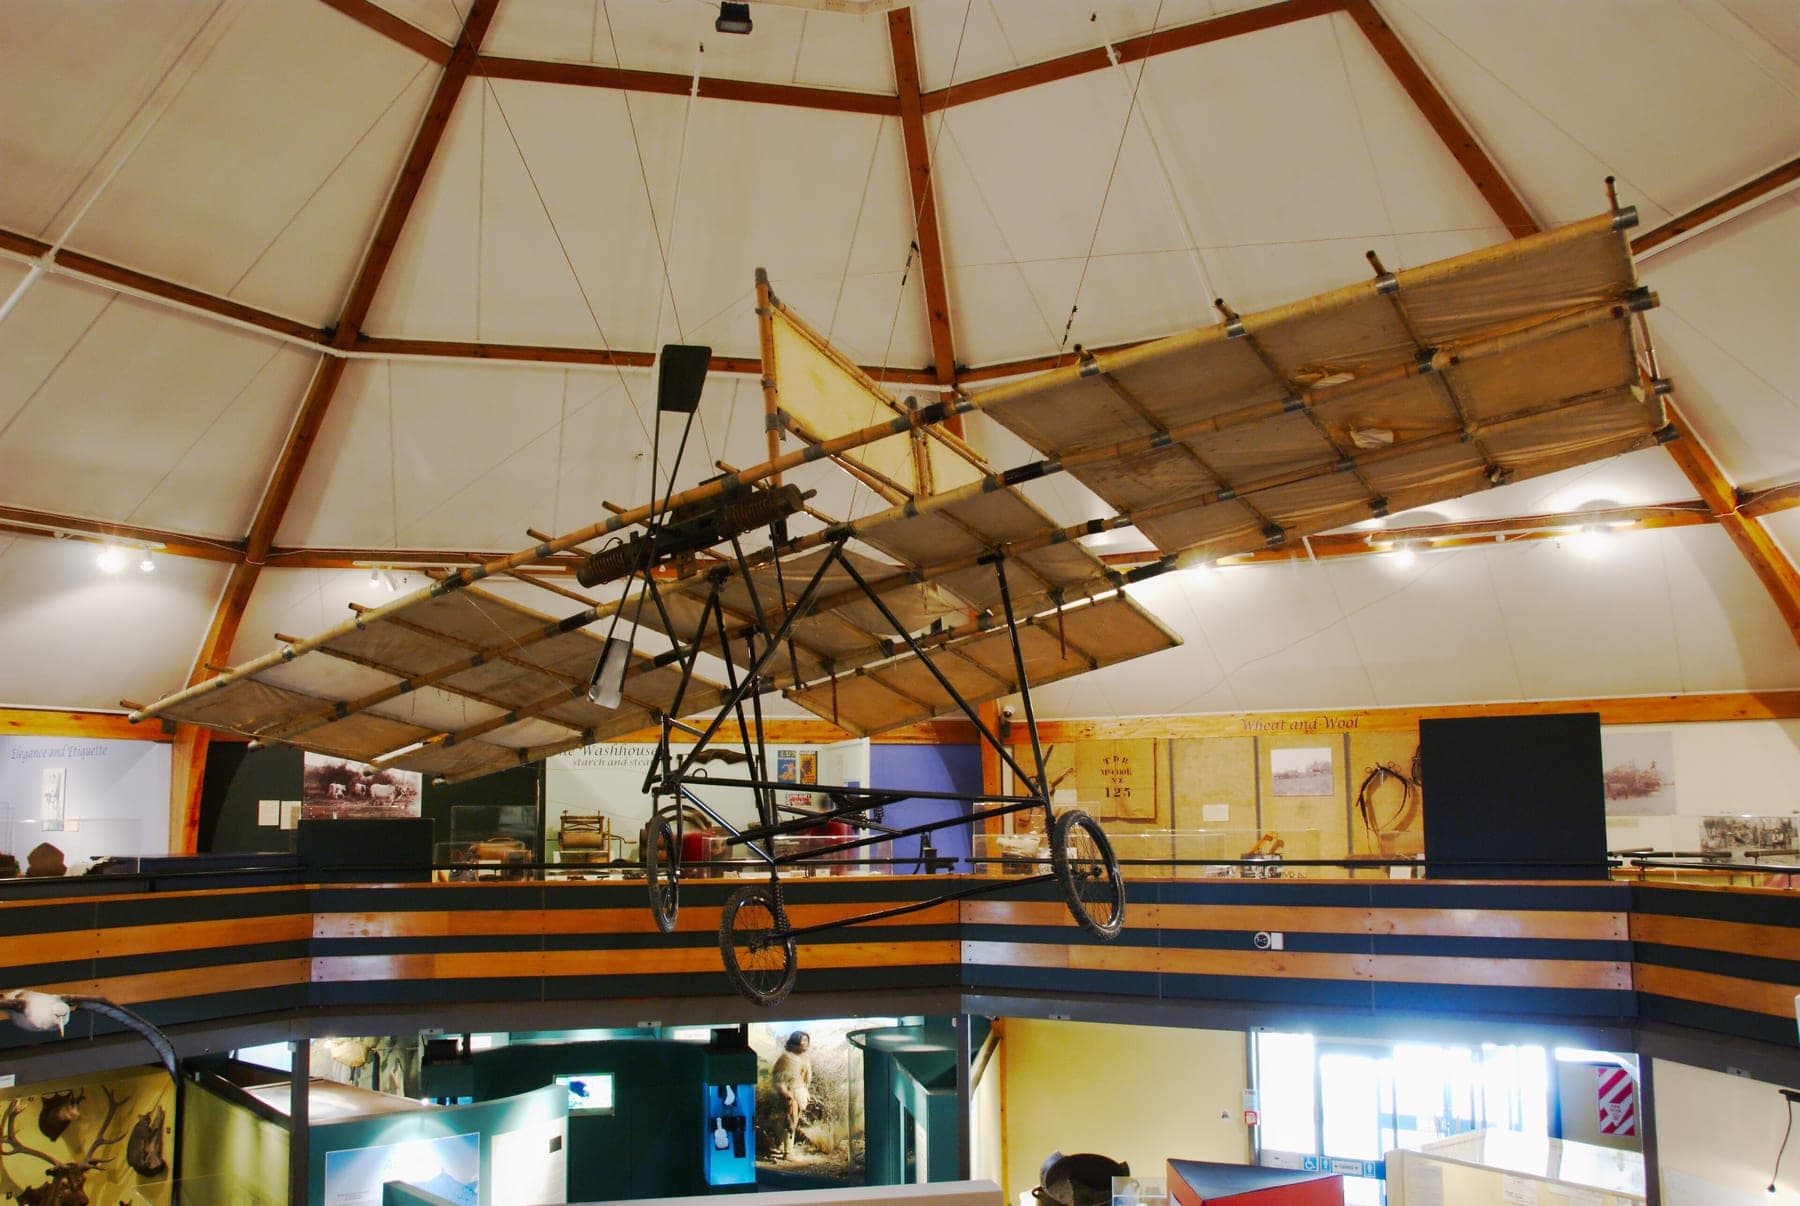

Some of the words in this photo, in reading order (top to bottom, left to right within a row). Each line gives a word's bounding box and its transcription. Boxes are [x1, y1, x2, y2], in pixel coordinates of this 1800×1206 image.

[1240, 718, 1287, 731] Wheat
[1289, 718, 1319, 730] and
[1321, 716, 1360, 729] Wool
[10, 747, 47, 764] Elegance
[48, 747, 65, 758] and
[66, 745, 109, 760] Etiquette
[583, 743, 657, 757] Washhouse
[573, 758, 605, 767] starch
[607, 758, 627, 767] and
[1105, 787, 1131, 798] 125
